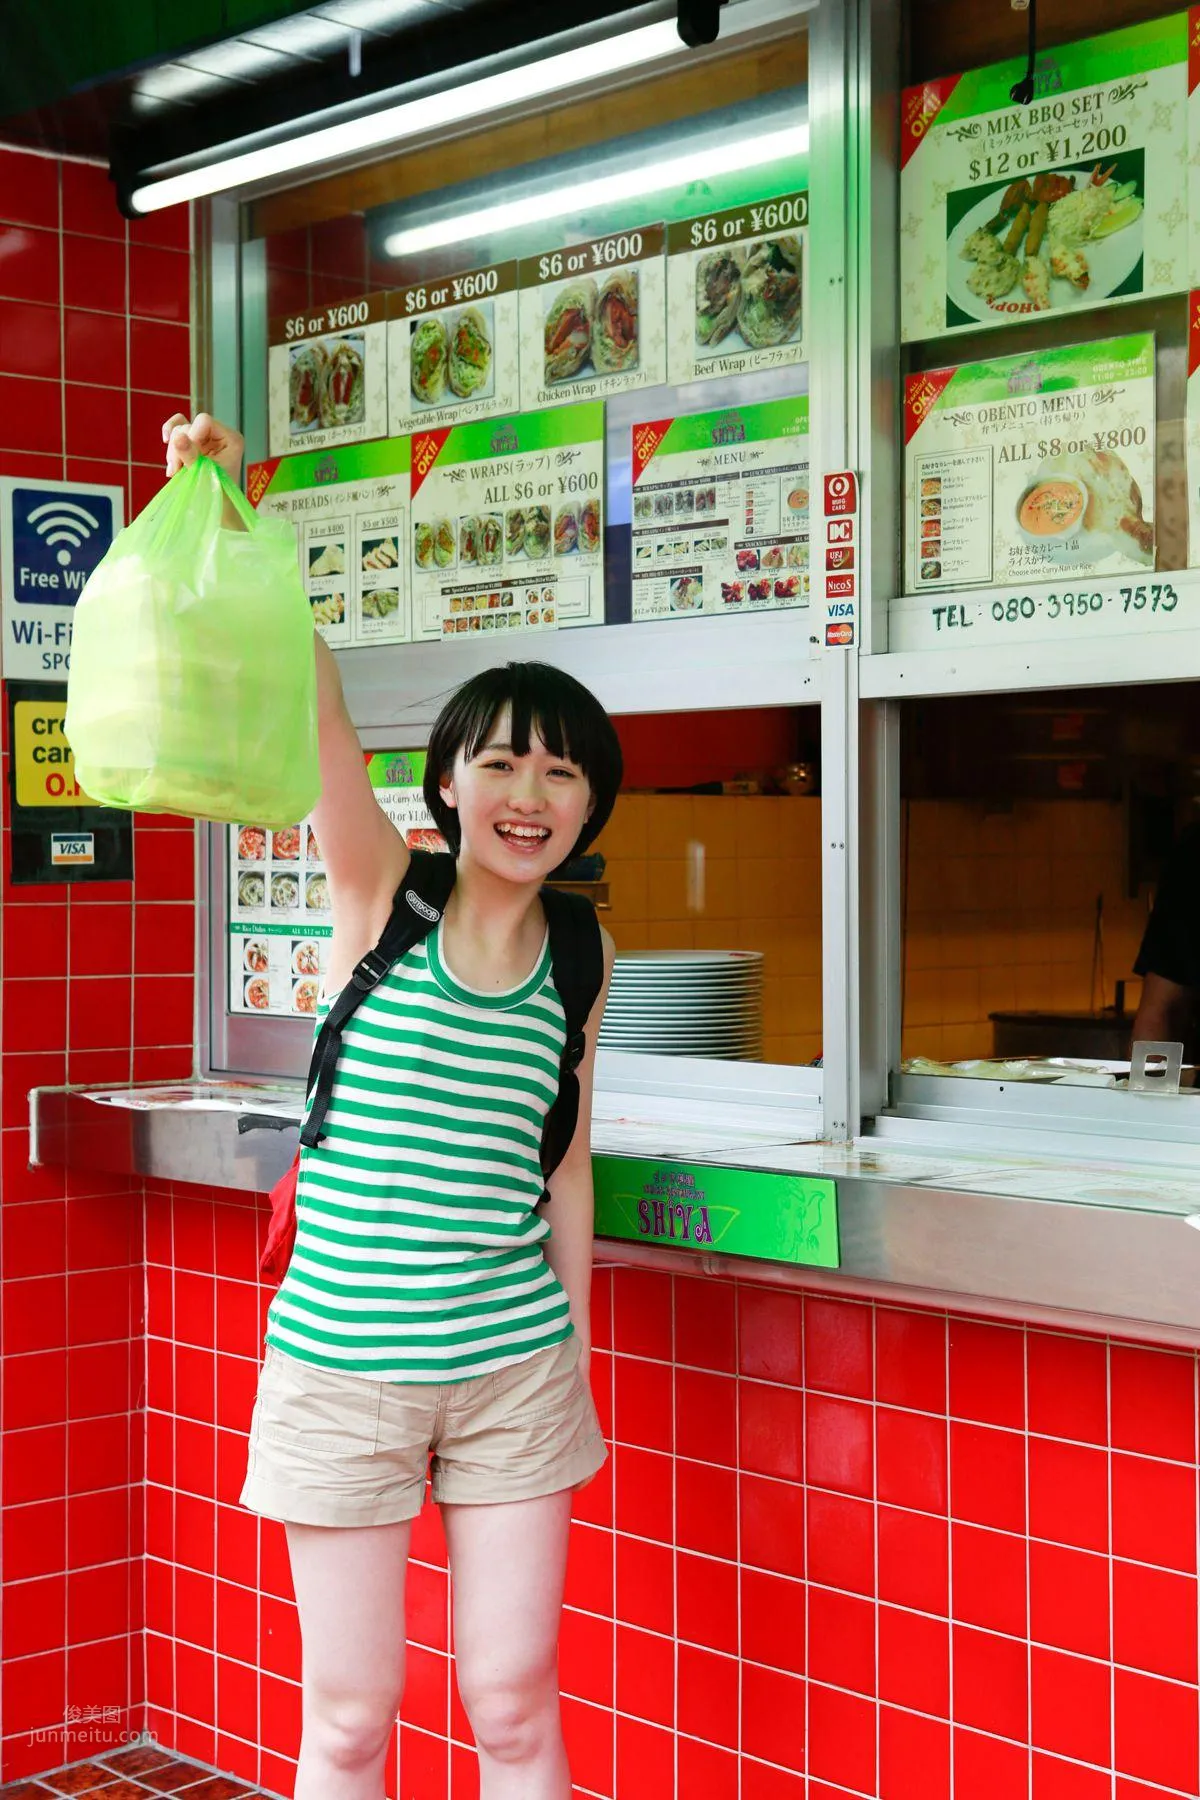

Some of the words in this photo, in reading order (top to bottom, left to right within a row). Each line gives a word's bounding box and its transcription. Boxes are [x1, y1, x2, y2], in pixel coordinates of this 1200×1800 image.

[987, 112, 1022, 137] MIX
[1028, 104, 1065, 130] BBQ
[1071, 92, 1105, 116] SET
[968, 152, 1010, 182] $12
[1016, 150, 1039, 169] or
[1045, 124, 1127, 163] ¥1,200
[690, 218, 717, 247] $6
[722, 217, 745, 238] or
[749, 198, 808, 232] ¥600
[539, 253, 563, 280] $6
[567, 250, 587, 270] or
[591, 232, 643, 265] ¥600
[405, 287, 427, 313] $6
[431, 288, 449, 306] or
[453, 270, 499, 300] ¥600
[285, 316, 305, 340] $6
[308, 317, 324, 334] or
[327, 301, 369, 330] ¥600
[693, 361, 715, 377] Beef
[718, 357, 746, 378] Wrap
[537, 383, 571, 404] Chicken
[571, 381, 597, 400] Wrap
[912, 382, 937, 416] OK!!
[398, 413, 436, 431] Vegetable
[435, 410, 459, 423] Wrap
[977, 400, 1037, 425] OBENTO
[1041, 393, 1087, 415] MENU
[289, 434, 306, 449] Pork
[306, 433, 326, 446] Wrap
[637, 430, 657, 460] OK!!
[998, 442, 1032, 464] ALL
[1037, 438, 1062, 460] $8
[1068, 436, 1088, 454] or
[1093, 425, 1147, 452] ¥800
[417, 440, 438, 475] OK!!
[713, 451, 747, 466] MENU
[483, 485, 510, 505] ALL
[514, 481, 534, 501] $6
[538, 481, 554, 497] or
[558, 471, 598, 494] ¥600
[829, 551, 843, 560] UFJ
[20, 567, 60, 589] Free
[827, 603, 854, 617] VISA
[11, 620, 73, 647] Wi-Fi
[827, 630, 853, 638] MasterCard
[392, 794, 411, 806] Curry
[397, 812, 406, 821] or
[59, 843, 86, 854] VISA
[407, 891, 437, 920] OUTDOOR
